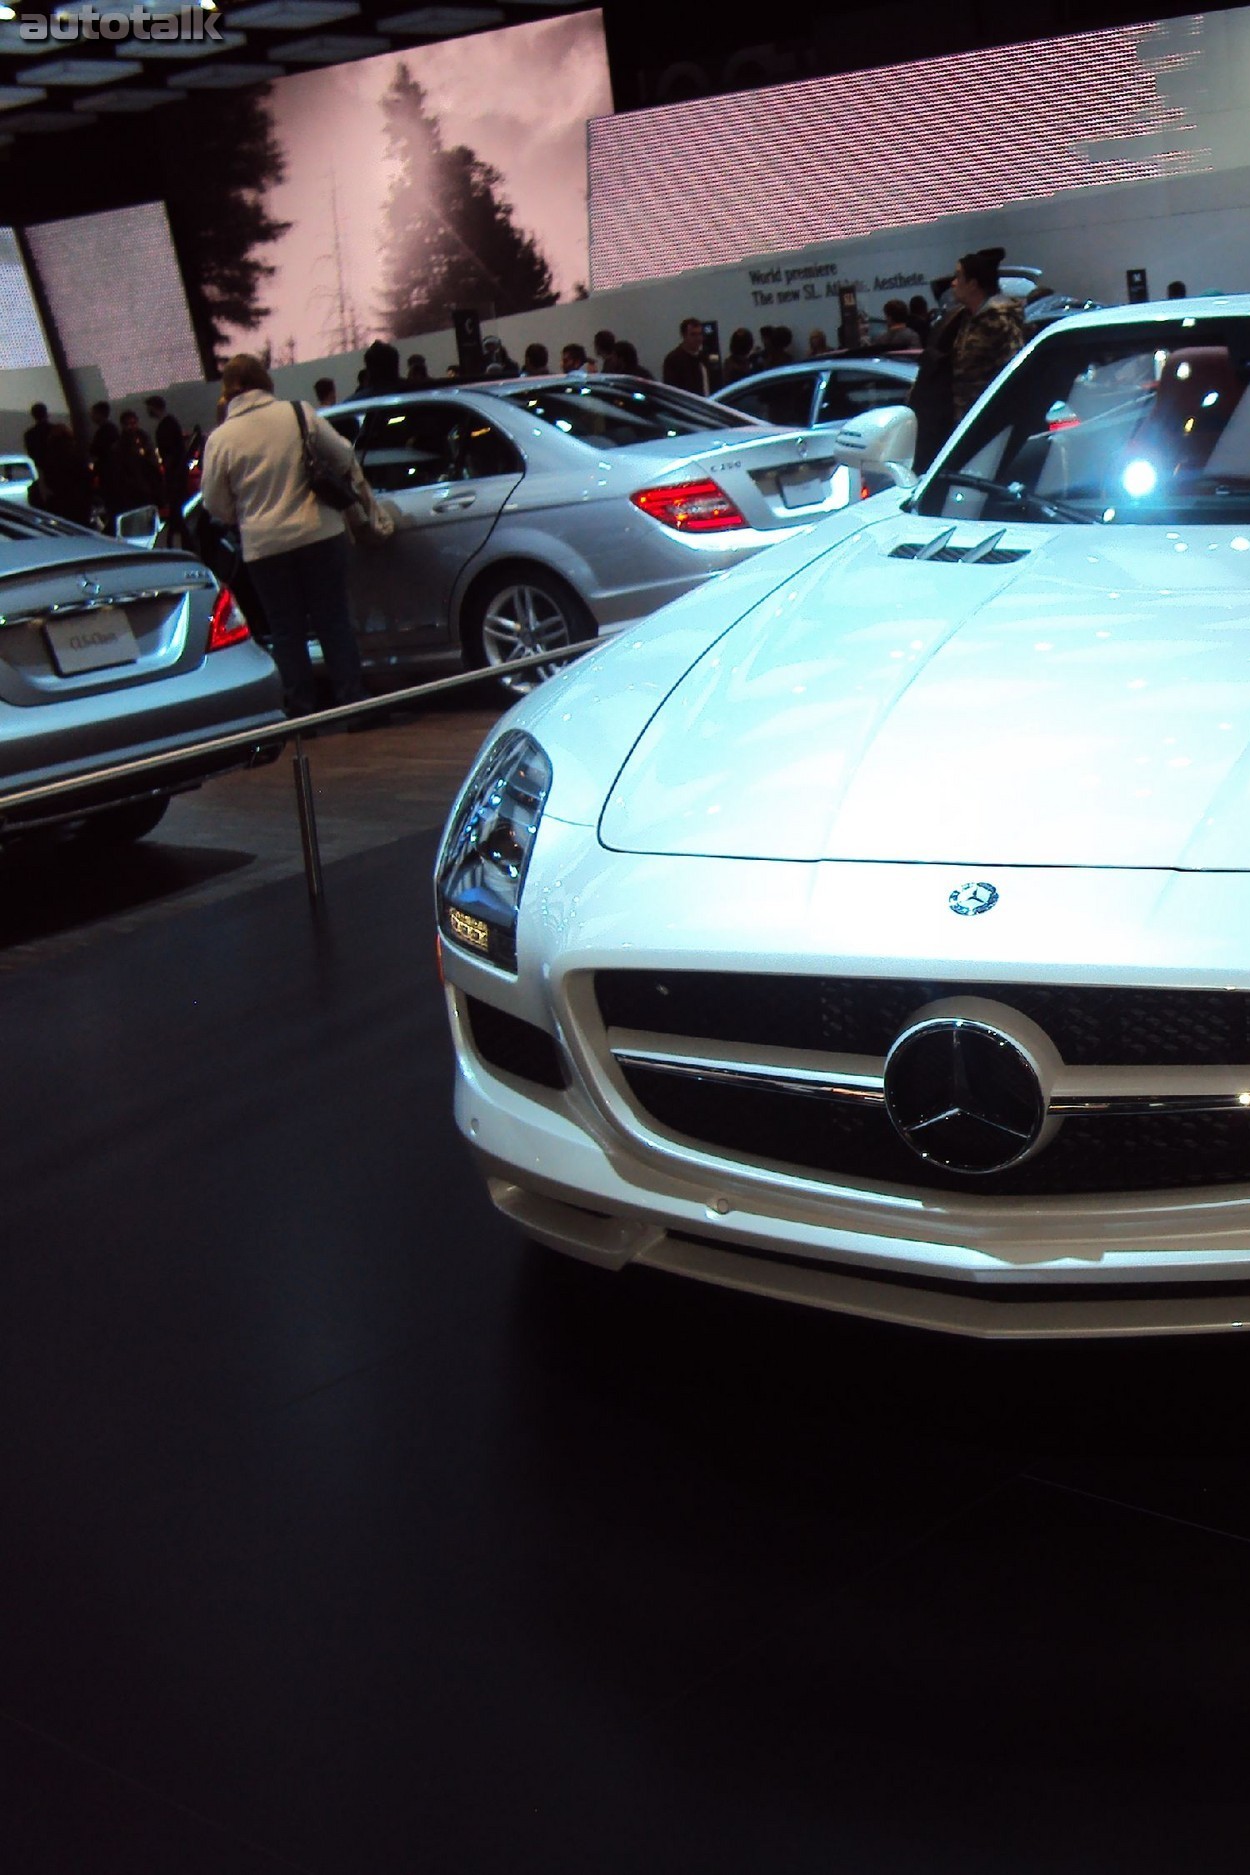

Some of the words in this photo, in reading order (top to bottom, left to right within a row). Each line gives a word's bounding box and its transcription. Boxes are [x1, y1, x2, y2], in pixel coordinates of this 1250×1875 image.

[750, 266, 782, 286] World
[784, 262, 838, 284] premiere
[751, 290, 774, 307] The
[776, 288, 801, 304] new
